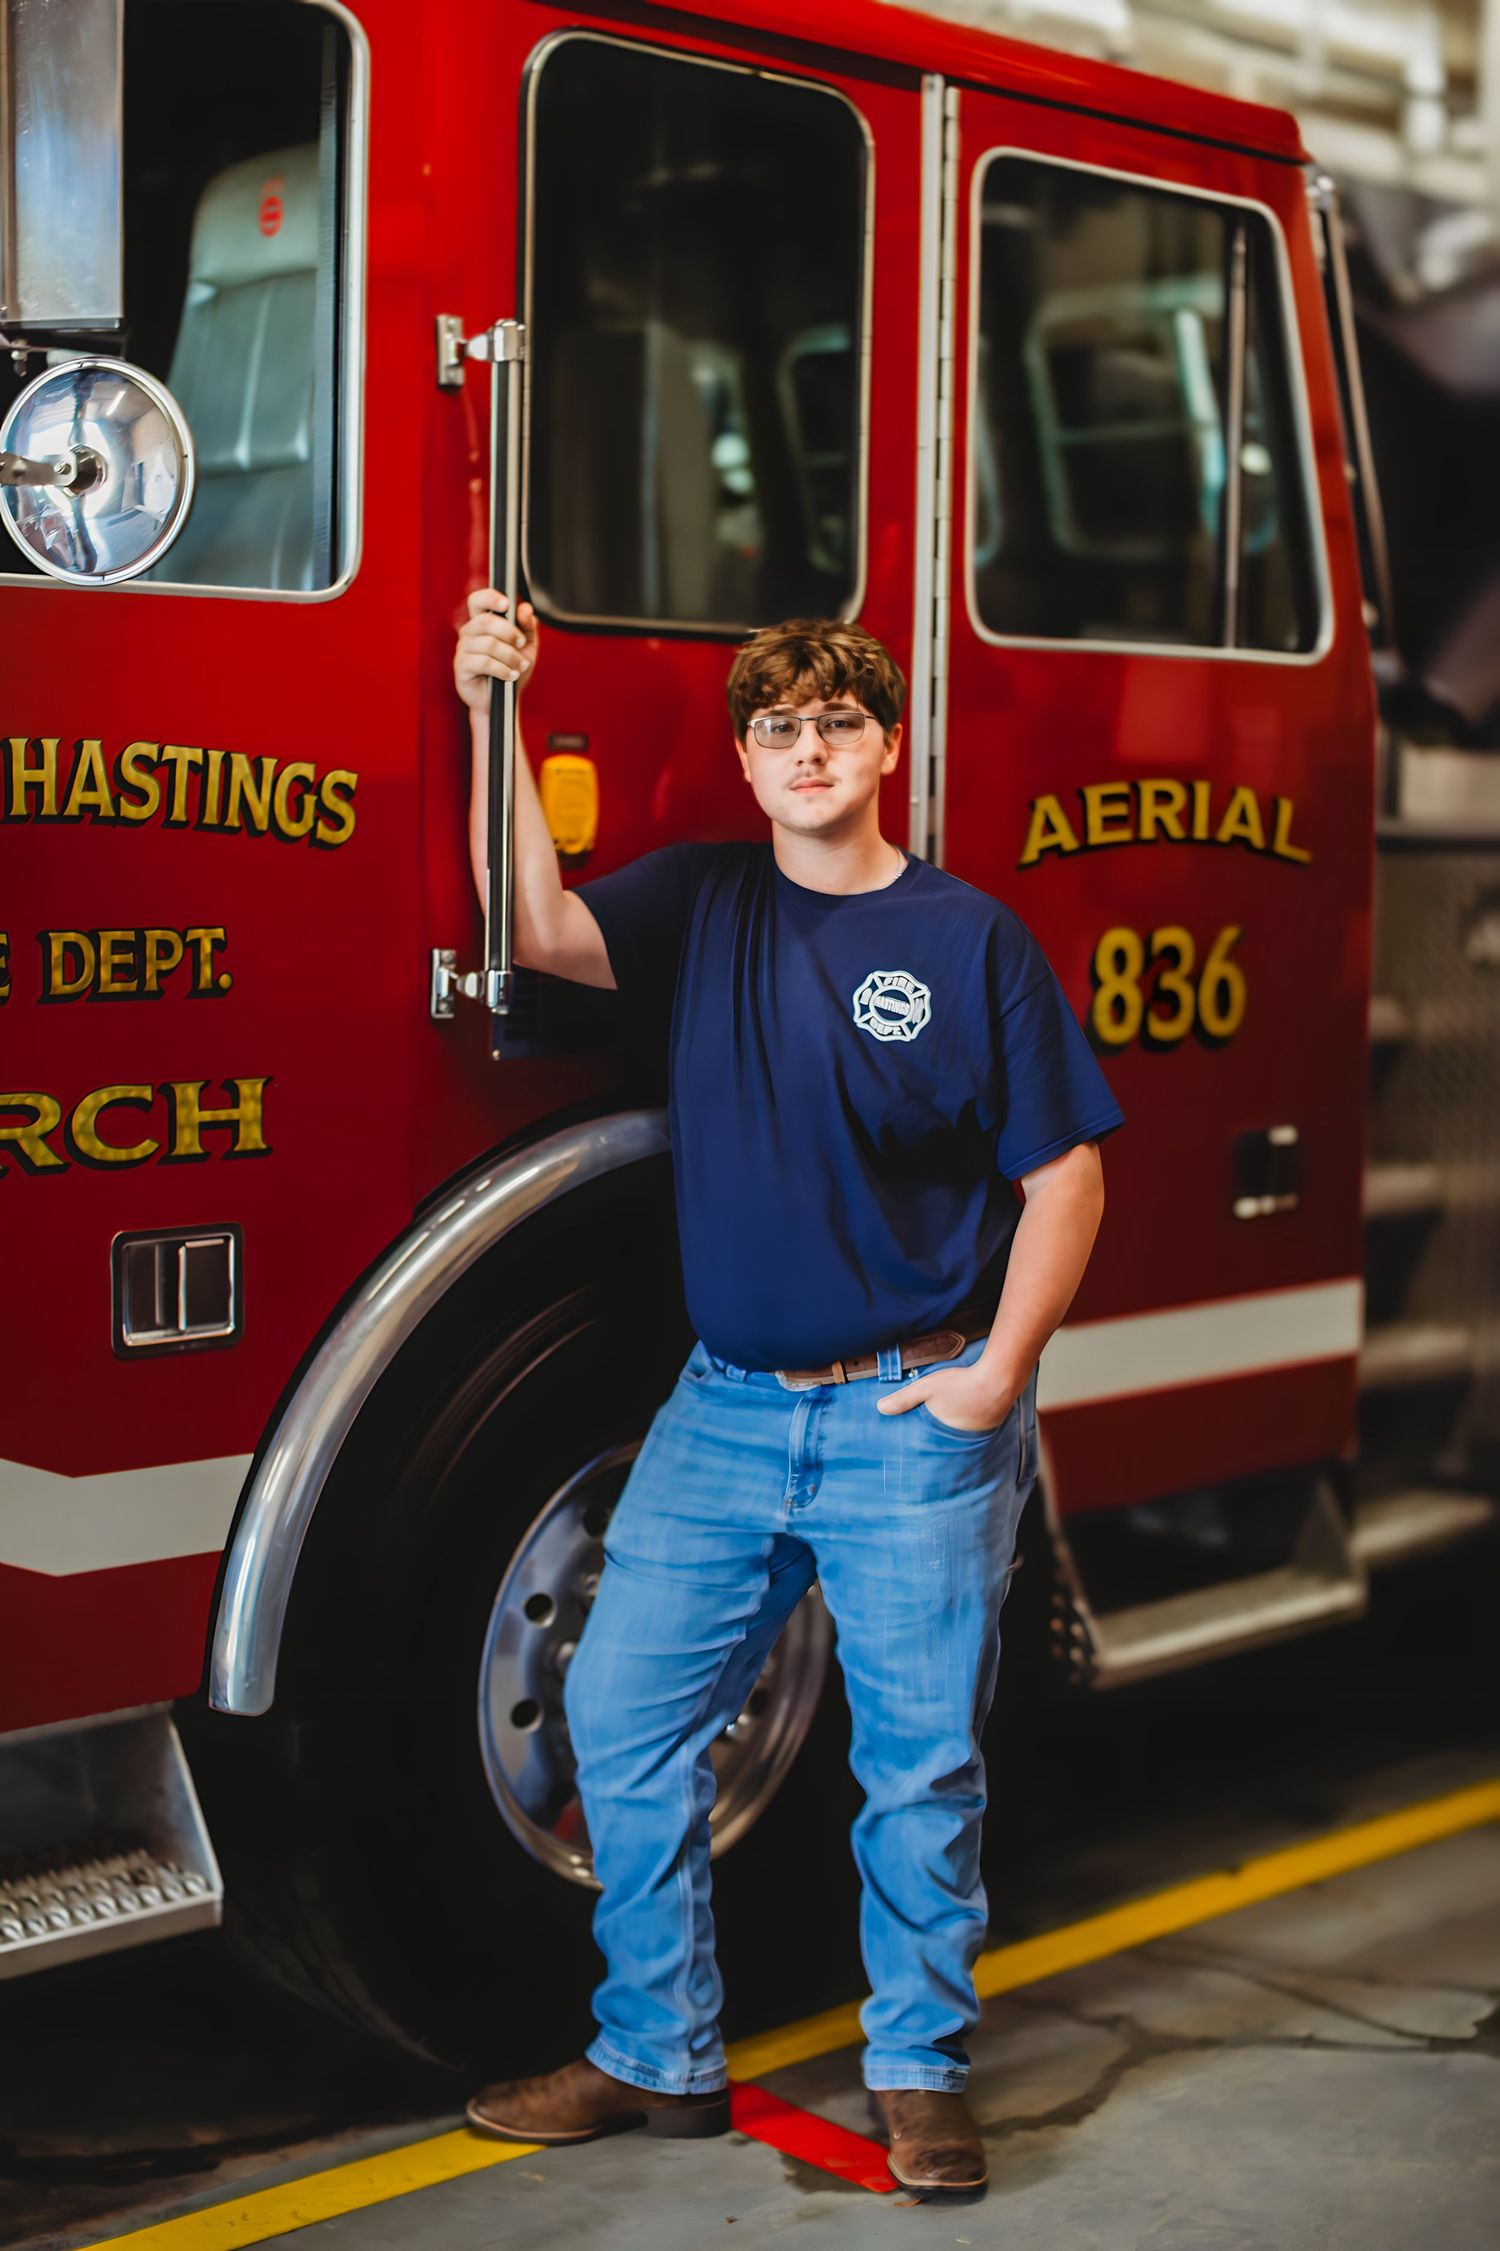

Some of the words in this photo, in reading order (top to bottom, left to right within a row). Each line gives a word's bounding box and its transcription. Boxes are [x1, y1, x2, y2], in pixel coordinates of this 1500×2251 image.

[5, 737, 359, 848] HASTINGS
[1018, 779, 1311, 867] AERIAL
[43, 927, 234, 999] DEPT.
[884, 977, 915, 994] FIRE
[1093, 925, 1247, 1046] 836
